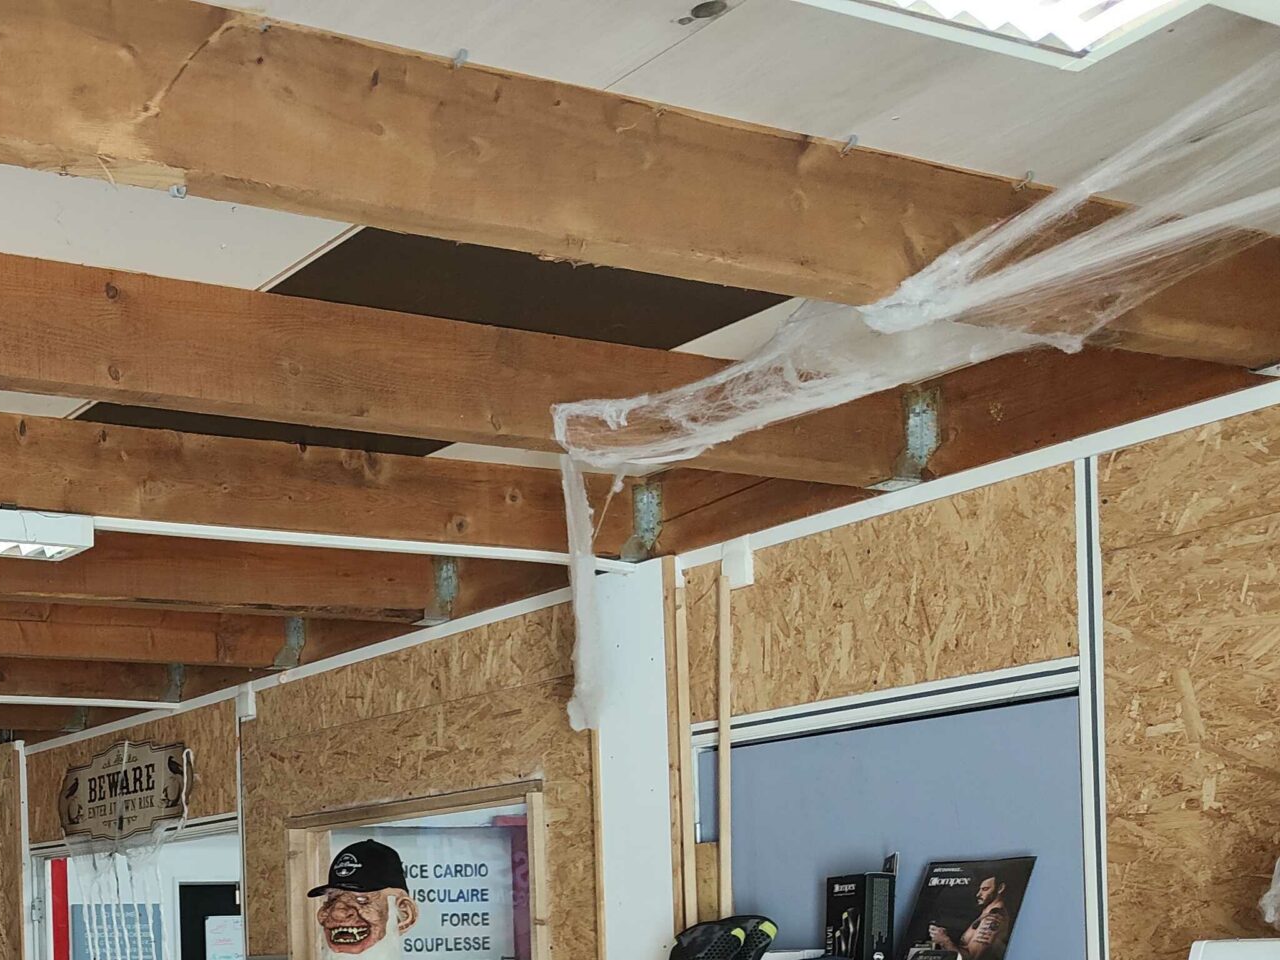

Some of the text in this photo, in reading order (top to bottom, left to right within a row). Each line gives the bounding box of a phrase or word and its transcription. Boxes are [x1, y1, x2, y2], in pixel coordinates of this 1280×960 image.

[87, 763, 155, 803] BEWARE
[138, 794, 155, 810] RISK
[433, 863, 489, 878] CARDIO
[440, 912, 490, 927] FORCE
[403, 936, 491, 953] SOUPLESSE
